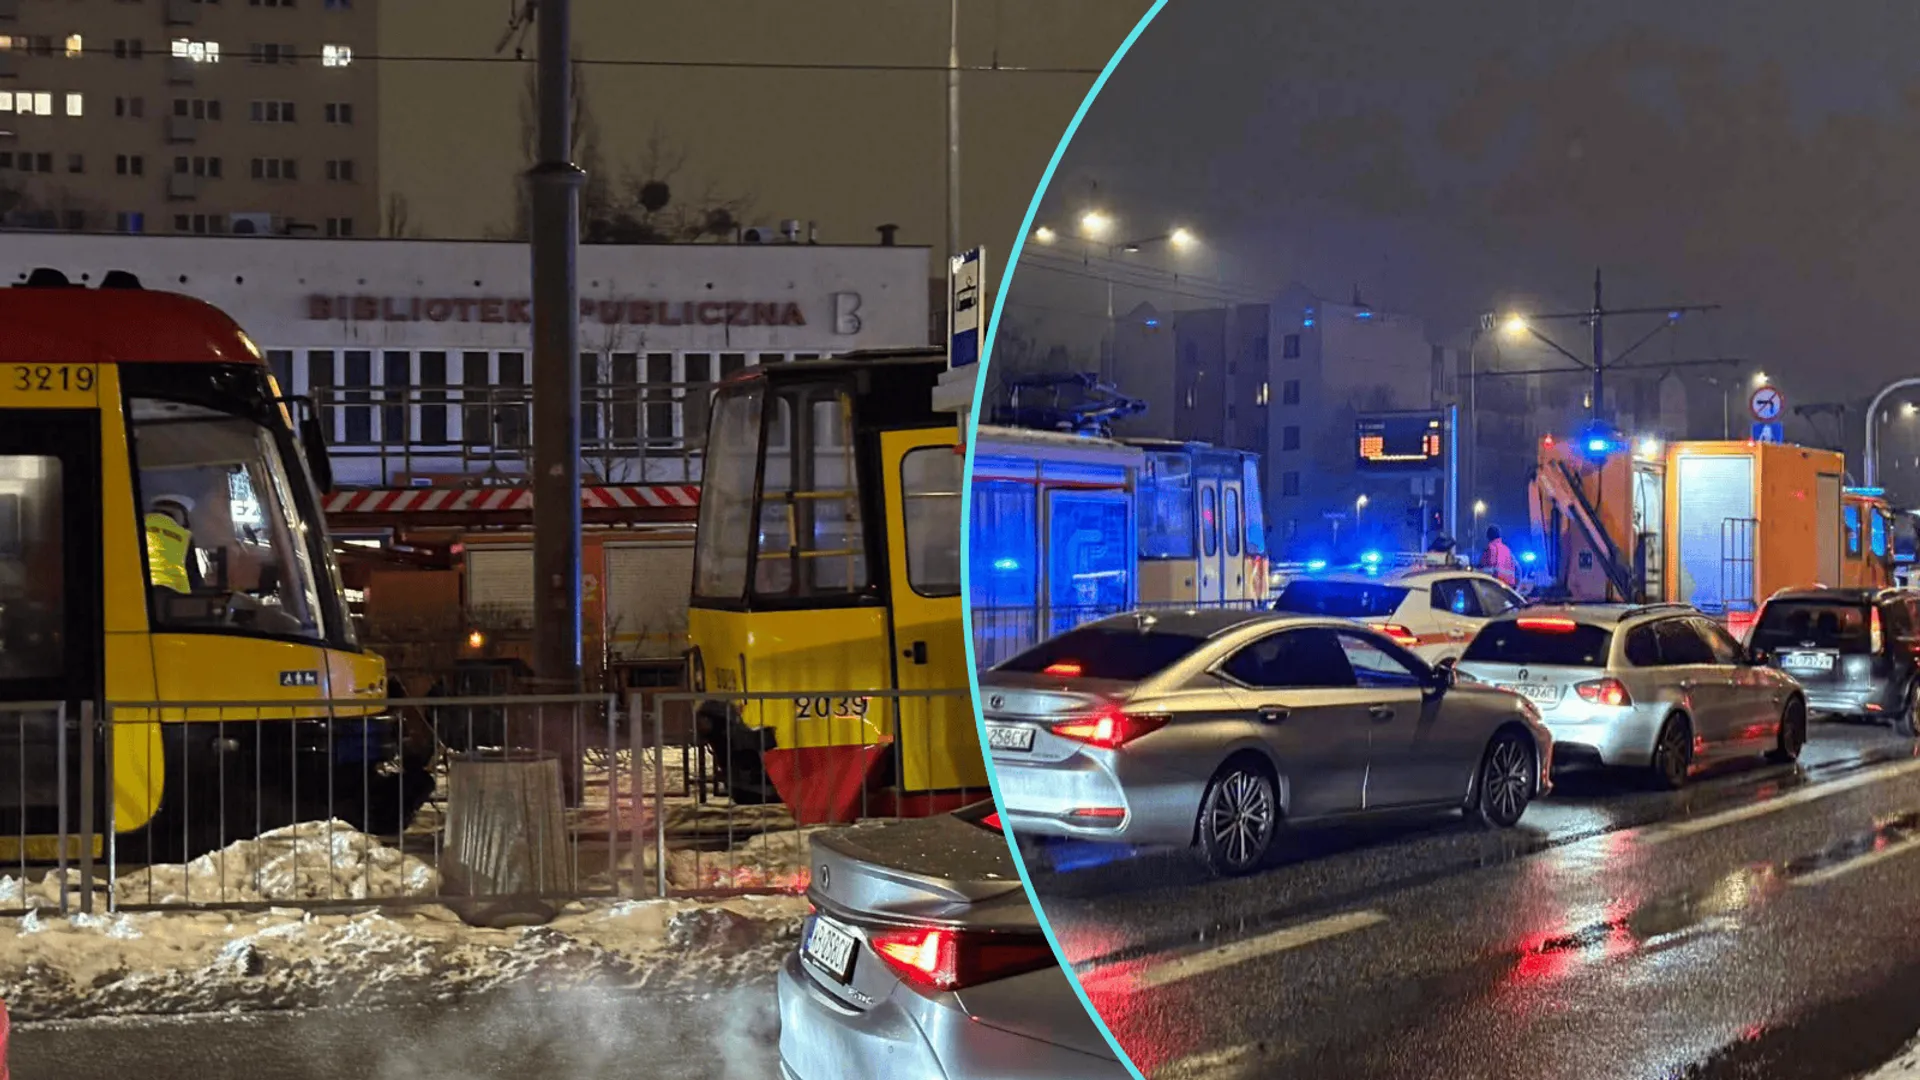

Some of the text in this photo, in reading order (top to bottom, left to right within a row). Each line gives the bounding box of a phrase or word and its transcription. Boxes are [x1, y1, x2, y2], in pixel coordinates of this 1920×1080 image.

[307, 295, 806, 326] BIBLIOTEK PUBLICZNA
[833, 292, 862, 335] B
[14, 366, 94, 391] 3219
[795, 697, 868, 718] 2039
[988, 728, 1030, 748] 258CK
